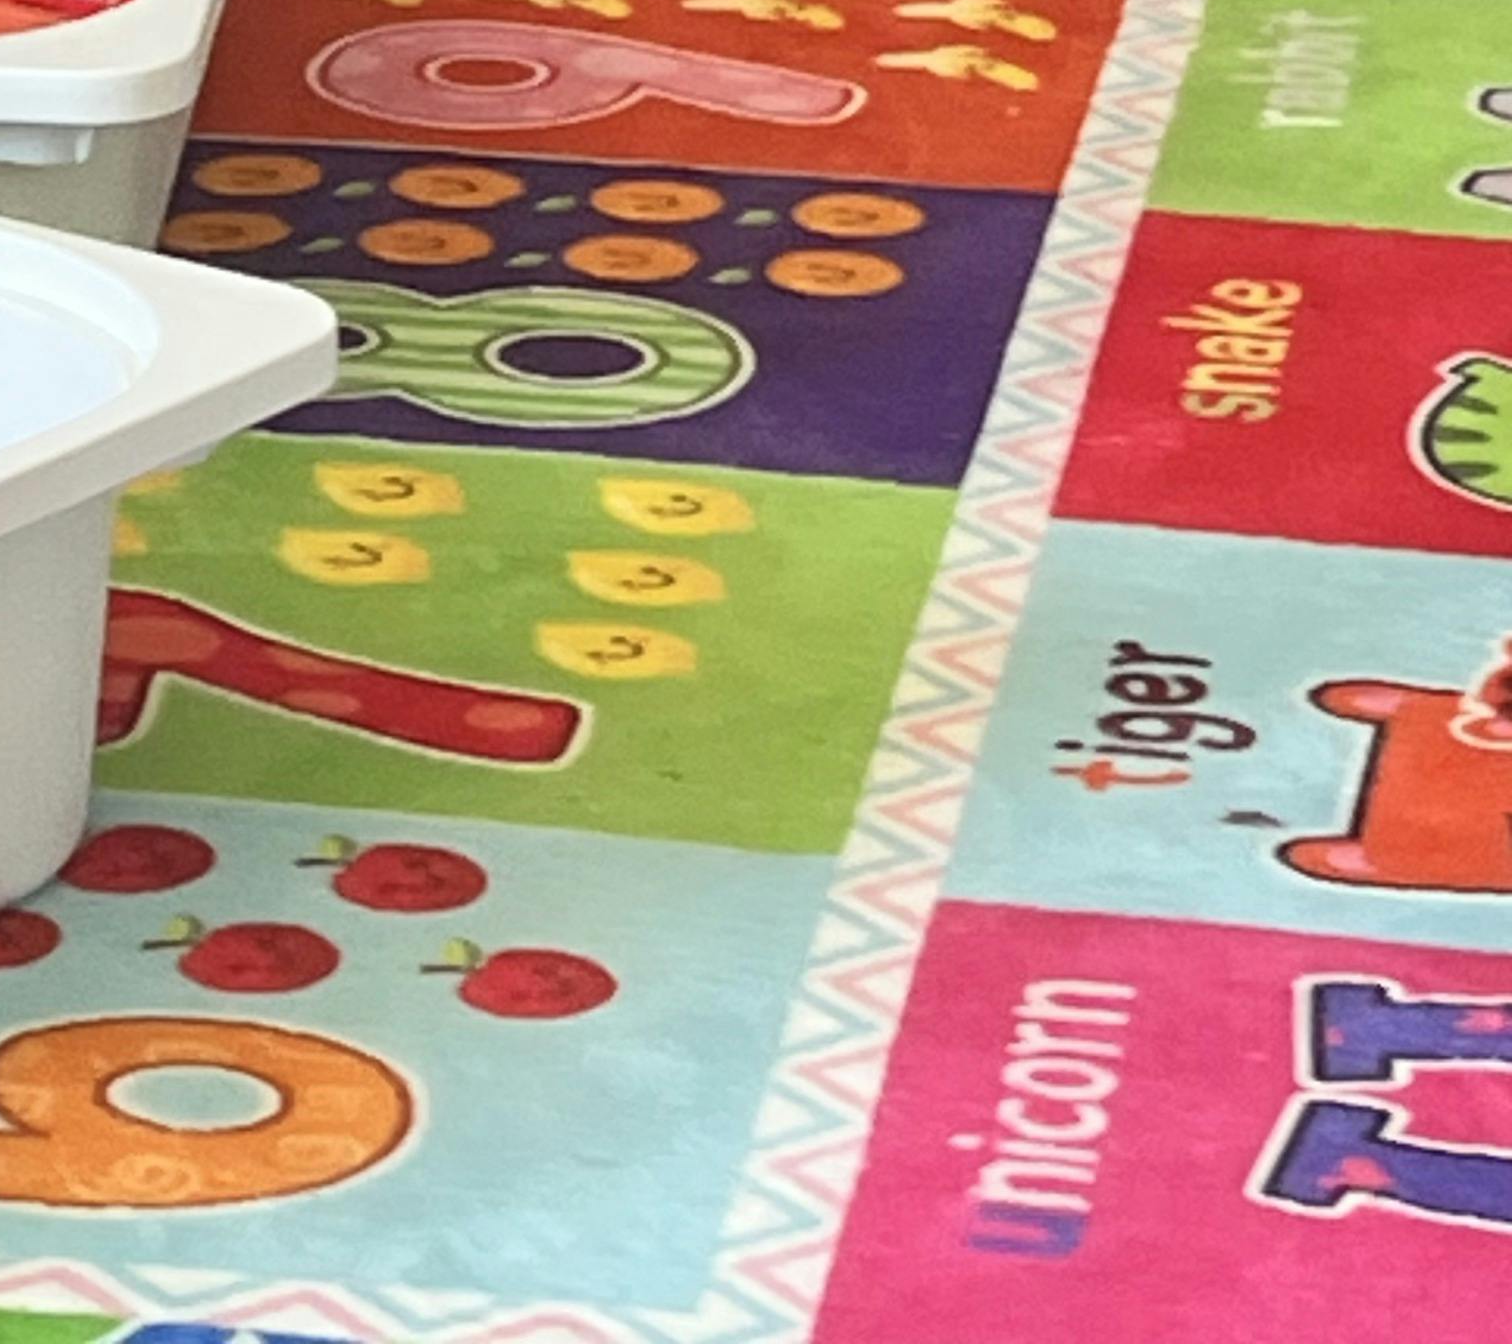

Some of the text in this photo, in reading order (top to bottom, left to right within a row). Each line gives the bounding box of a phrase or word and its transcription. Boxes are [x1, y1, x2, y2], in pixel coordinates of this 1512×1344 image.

[306, 18, 868, 130] 9
[1160, 277, 1304, 424] snake
[1050, 638, 1257, 793] tiger
[948, 978, 1138, 1260] unicorn
